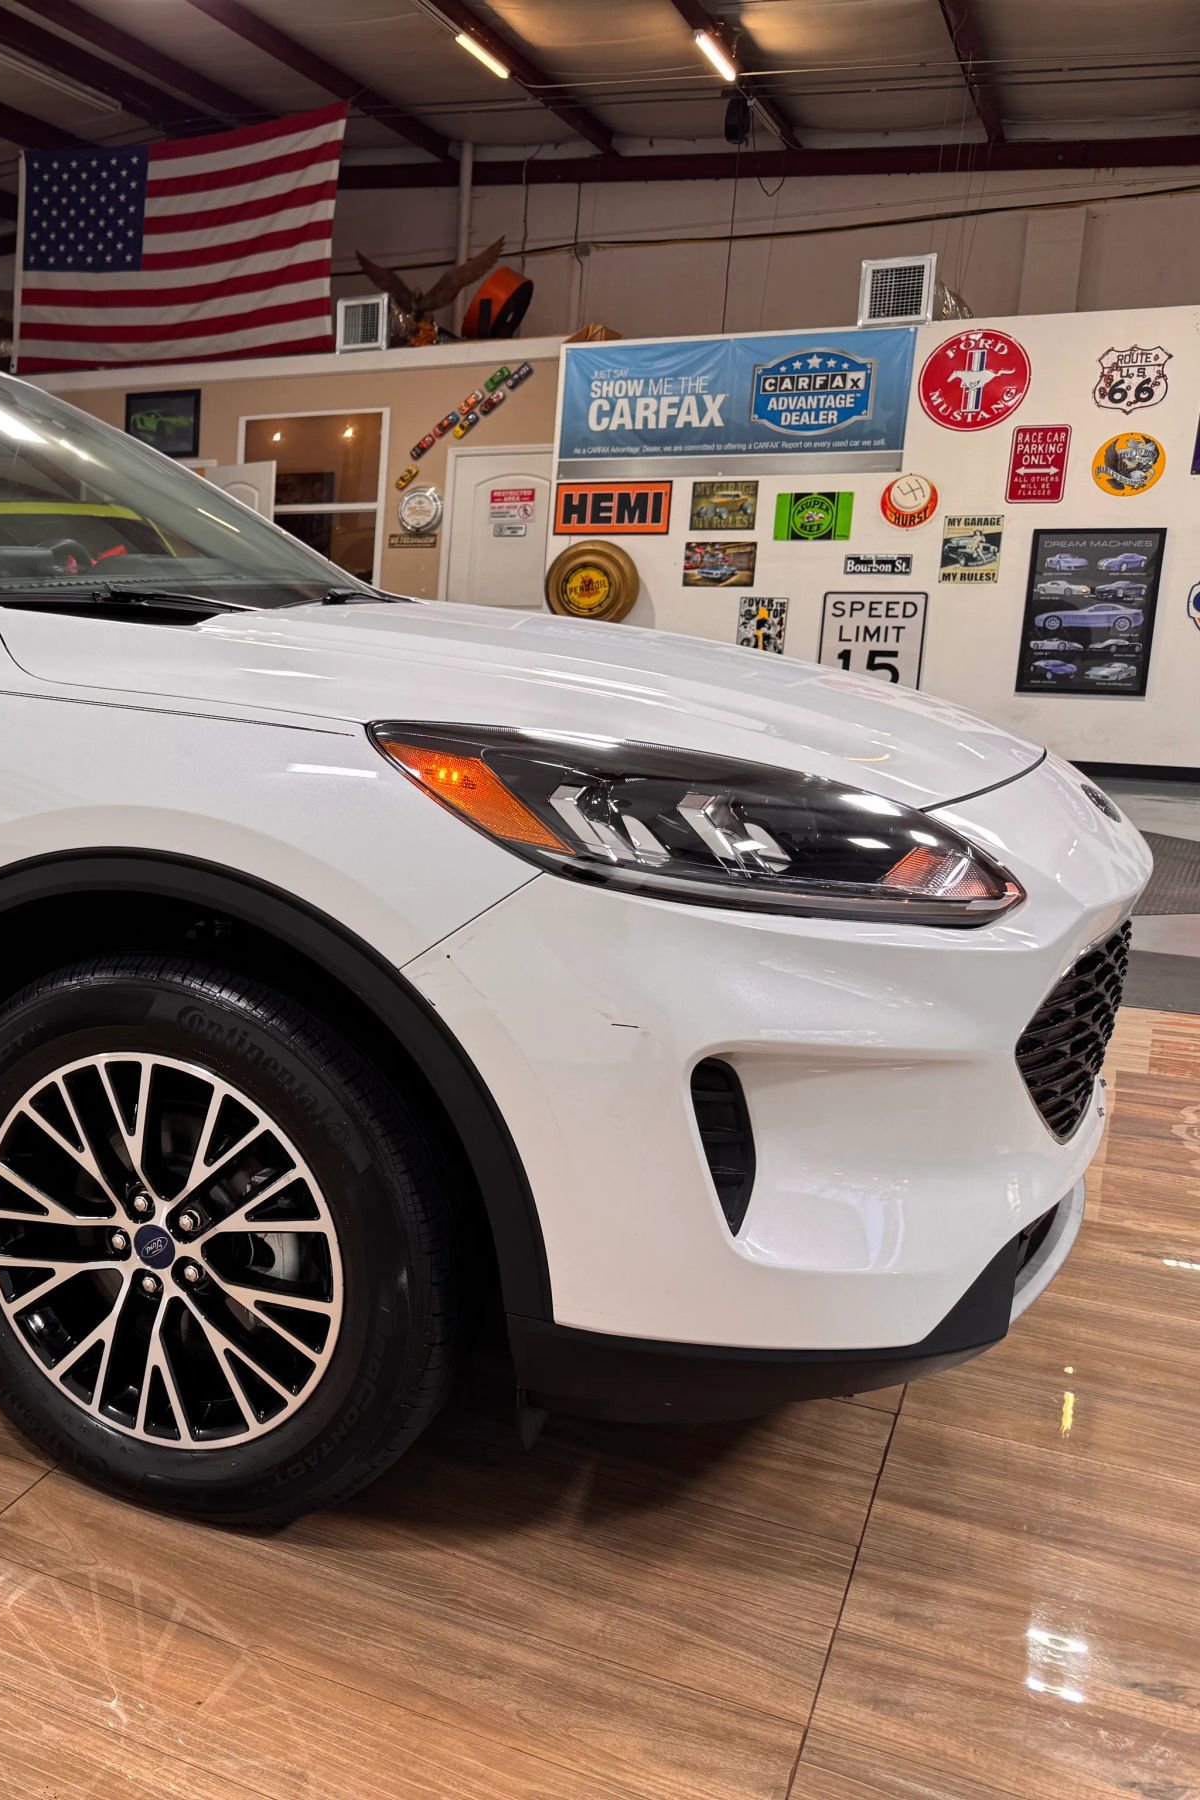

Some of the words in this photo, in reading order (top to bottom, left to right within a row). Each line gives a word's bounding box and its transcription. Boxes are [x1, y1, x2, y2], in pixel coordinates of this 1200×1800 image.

[945, 338, 1008, 359] FORD
[1116, 352, 1152, 365] ROUTE
[591, 368, 611, 380] JUST
[612, 368, 629, 378] SAY
[590, 379, 644, 398] SHOW
[648, 377, 673, 396] ME
[677, 376, 710, 394] THE
[763, 374, 862, 392] CARFAX
[1108, 377, 1155, 404] 66
[767, 394, 856, 411] ADVANTAGE
[929, 386, 1018, 422] MUSTANG
[588, 394, 726, 432] CARFAX
[780, 410, 839, 426] DEALER
[1017, 432, 1044, 443] RACE
[1046, 432, 1066, 443] CAR
[1016, 443, 1064, 454] PARKING
[1022, 454, 1056, 465] ONLY
[694, 484, 711, 496] MY
[712, 482, 757, 495] GARAGE
[561, 491, 664, 525] HEMI
[797, 500, 831, 515] SUPER
[694, 516, 710, 529] MY
[894, 504, 929, 527] HURST
[947, 517, 962, 527] MY
[964, 517, 1002, 526] GARAGE
[800, 522, 824, 533] BEE
[1044, 540, 1087, 548] DREAM
[1089, 540, 1153, 548] MACHINES
[846, 559, 892, 573] Bourbon
[894, 559, 910, 573] St.
[942, 573, 958, 581] MY
[960, 572, 996, 581] RULES!
[748, 598, 774, 608] OVER
[831, 601, 918, 618] SPEED
[838, 625, 906, 643] LIMIT
[837, 649, 900, 685] 15
